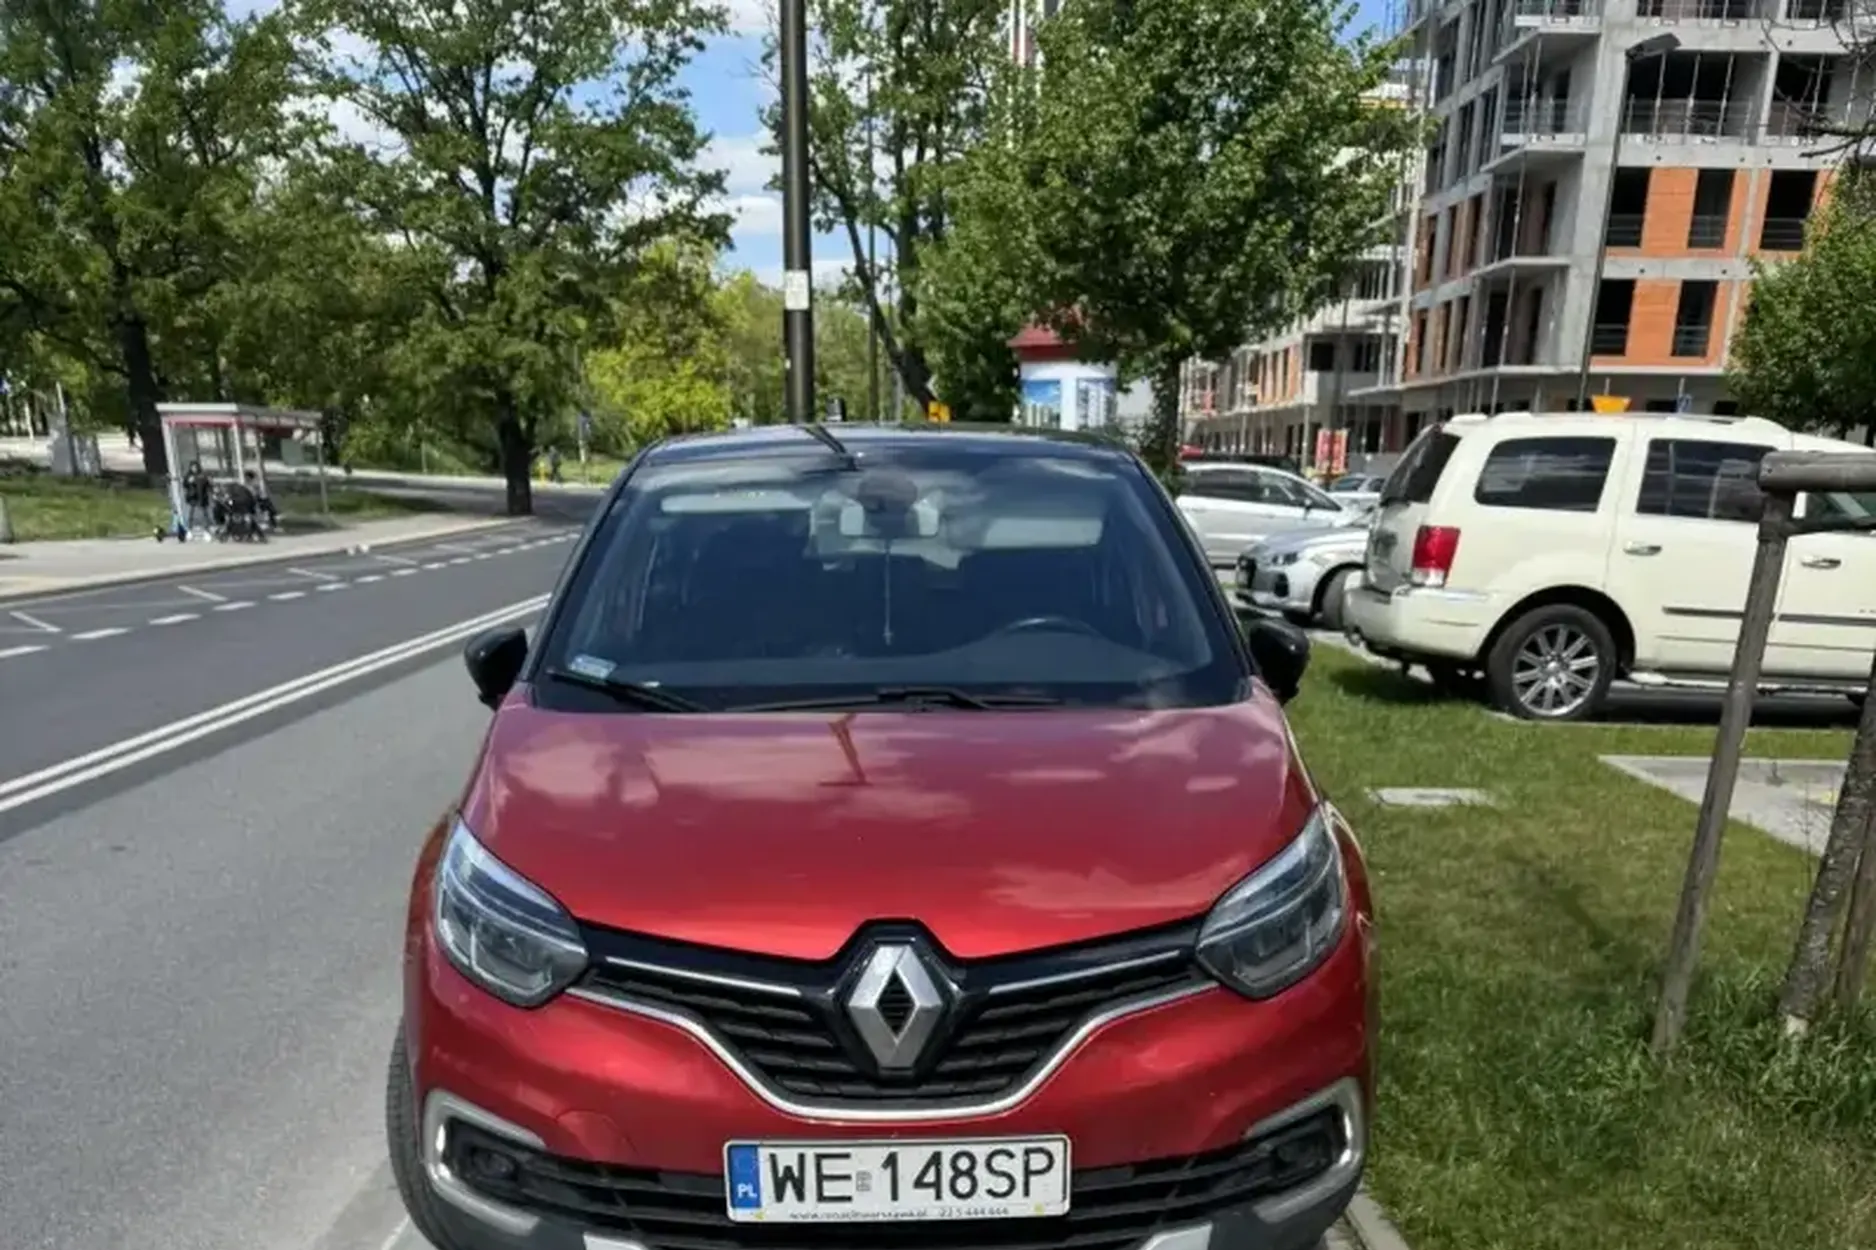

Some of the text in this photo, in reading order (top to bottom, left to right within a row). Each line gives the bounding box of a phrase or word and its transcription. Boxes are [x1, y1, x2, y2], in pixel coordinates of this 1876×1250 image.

[737, 1183, 757, 1198] PL
[768, 1146, 1056, 1203] WE 148SP
